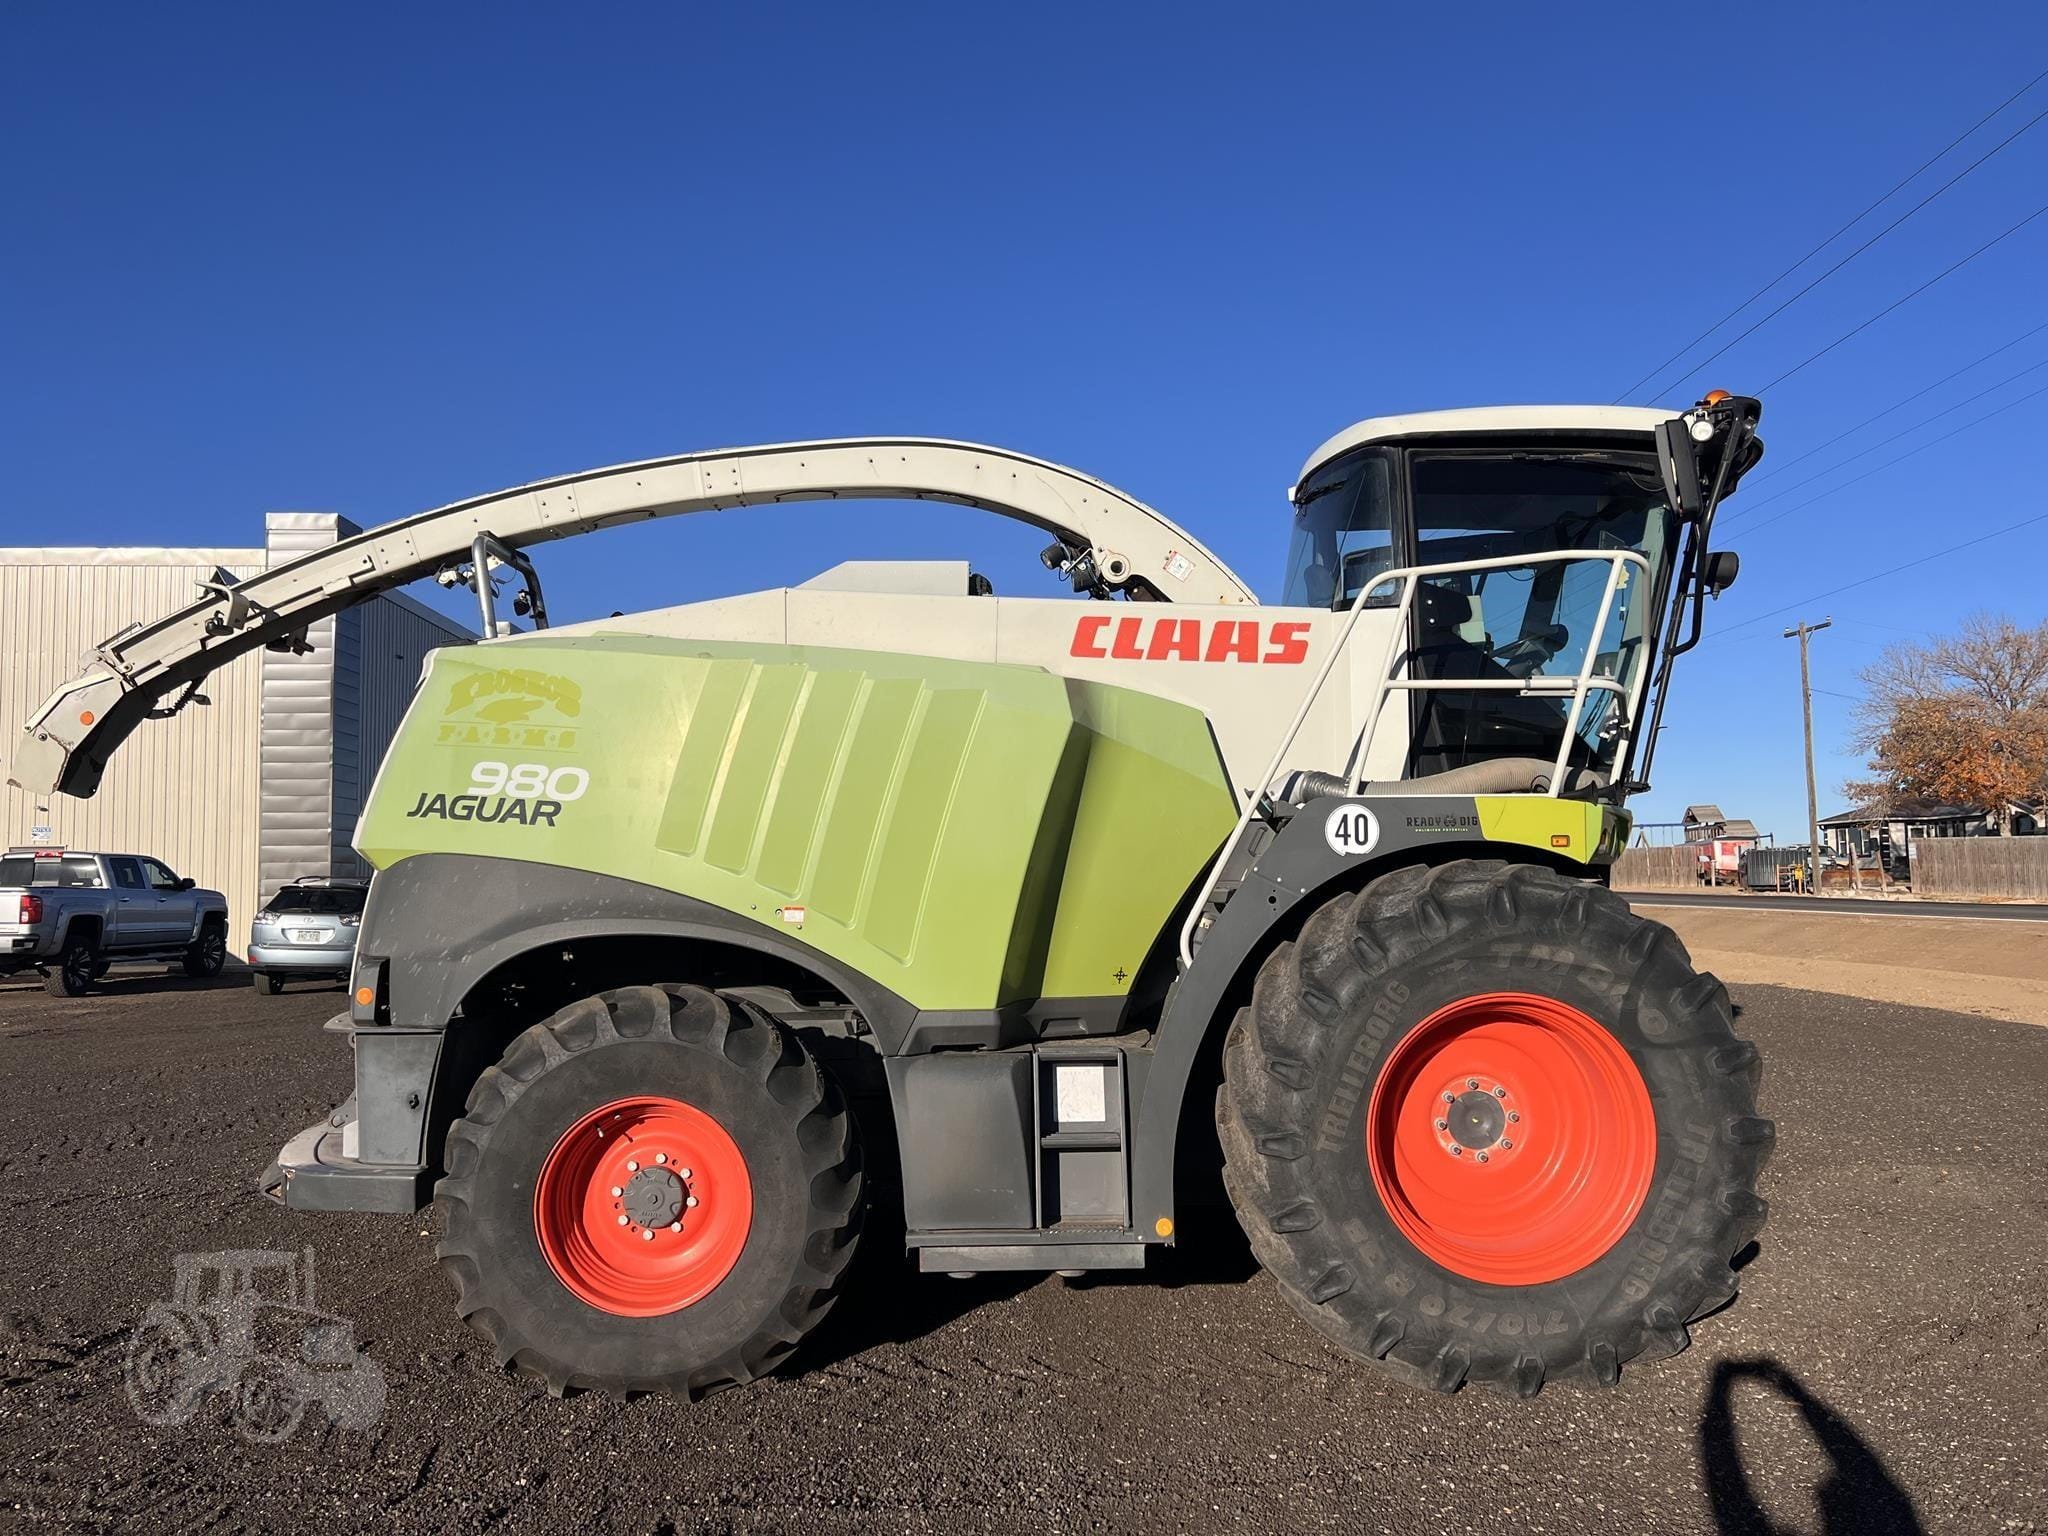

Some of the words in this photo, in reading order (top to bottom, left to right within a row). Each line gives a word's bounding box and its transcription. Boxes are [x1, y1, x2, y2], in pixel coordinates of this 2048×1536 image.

[1070, 616, 1311, 664] CLAAS
[467, 761, 590, 801] 980
[407, 792, 563, 827] JAGUAR
[1335, 813, 1369, 846] 40
[1406, 816, 1441, 828] READY
[1459, 815, 1478, 827] DIG
[1316, 980, 1410, 1153] TRELLEBORG
[1621, 1122, 1716, 1300] TRELLEBORG
